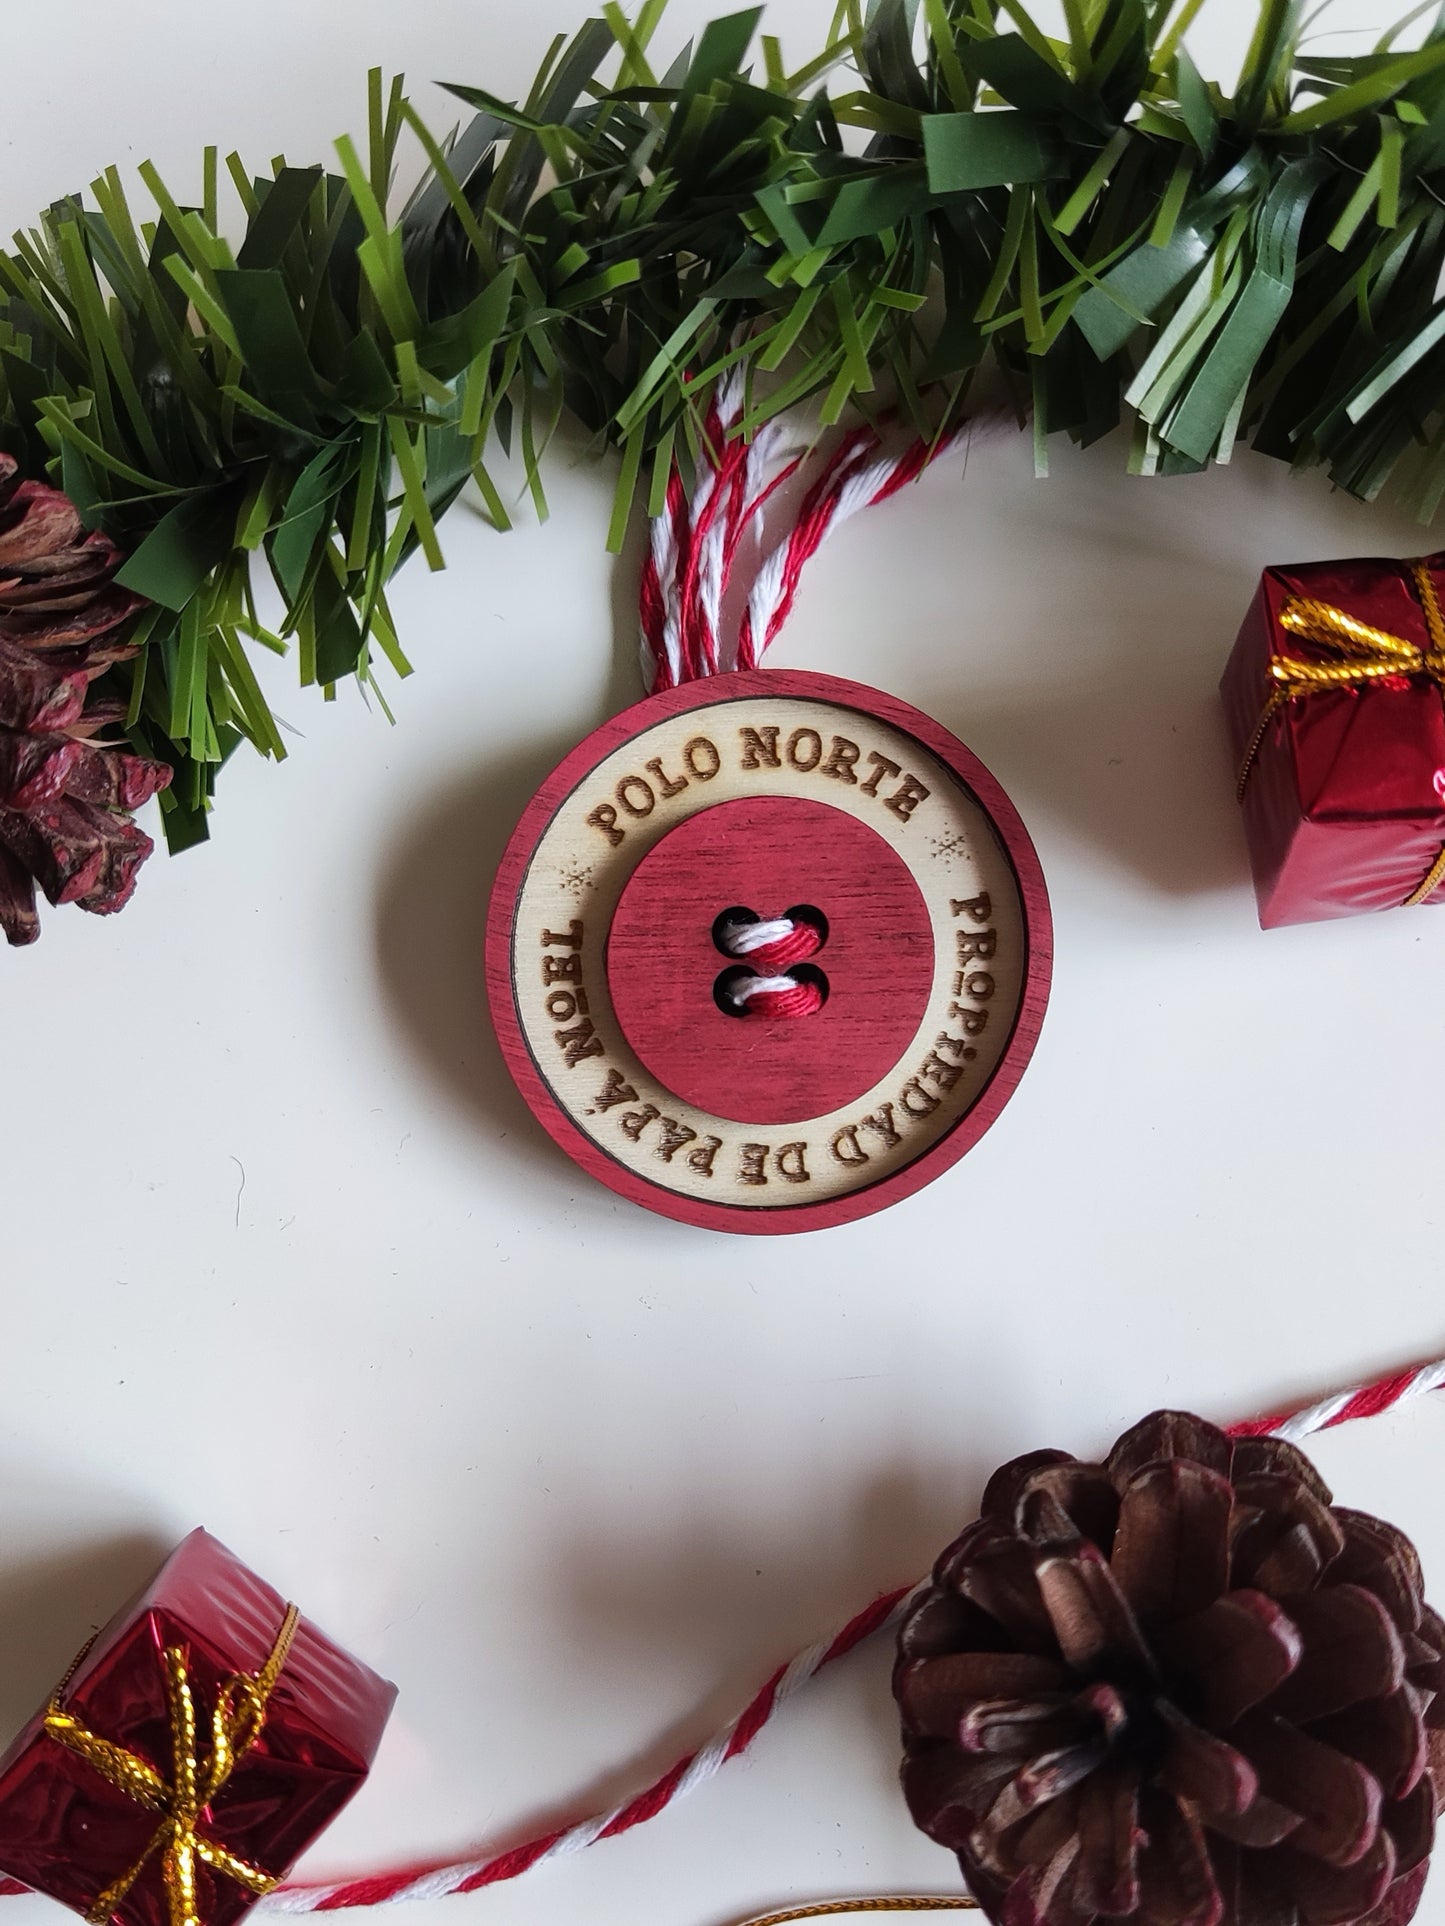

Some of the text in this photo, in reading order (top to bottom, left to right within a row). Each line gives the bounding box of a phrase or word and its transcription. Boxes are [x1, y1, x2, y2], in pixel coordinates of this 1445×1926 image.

[585, 726, 932, 848] POLO NORTE
[540, 919, 605, 1069] NOEL
[735, 1141, 811, 1186] DE
